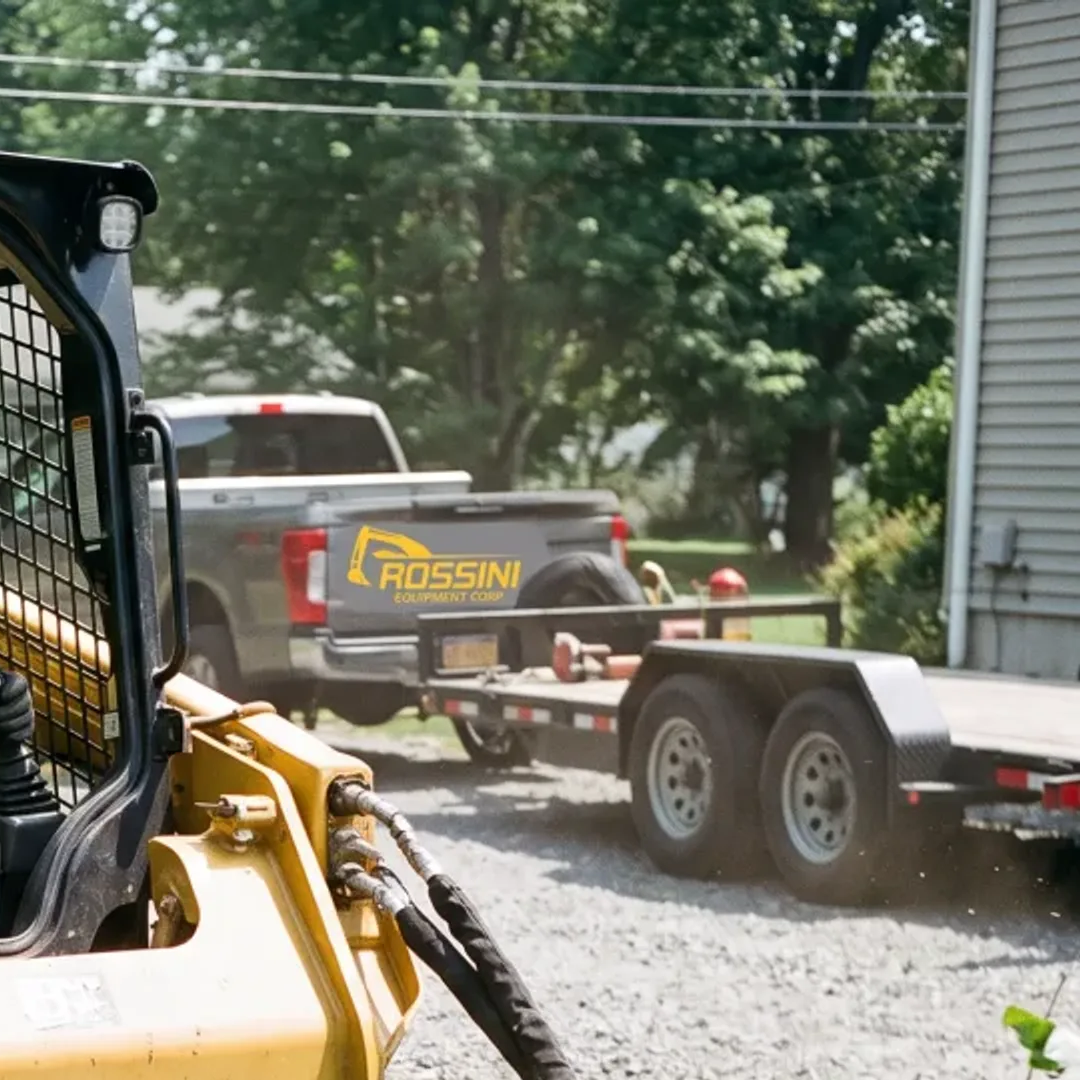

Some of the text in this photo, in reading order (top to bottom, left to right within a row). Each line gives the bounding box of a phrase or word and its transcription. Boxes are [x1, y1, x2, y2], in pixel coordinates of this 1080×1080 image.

[379, 560, 521, 589] ROSSINI
[393, 591, 503, 603] EQUIPMENT CORP
